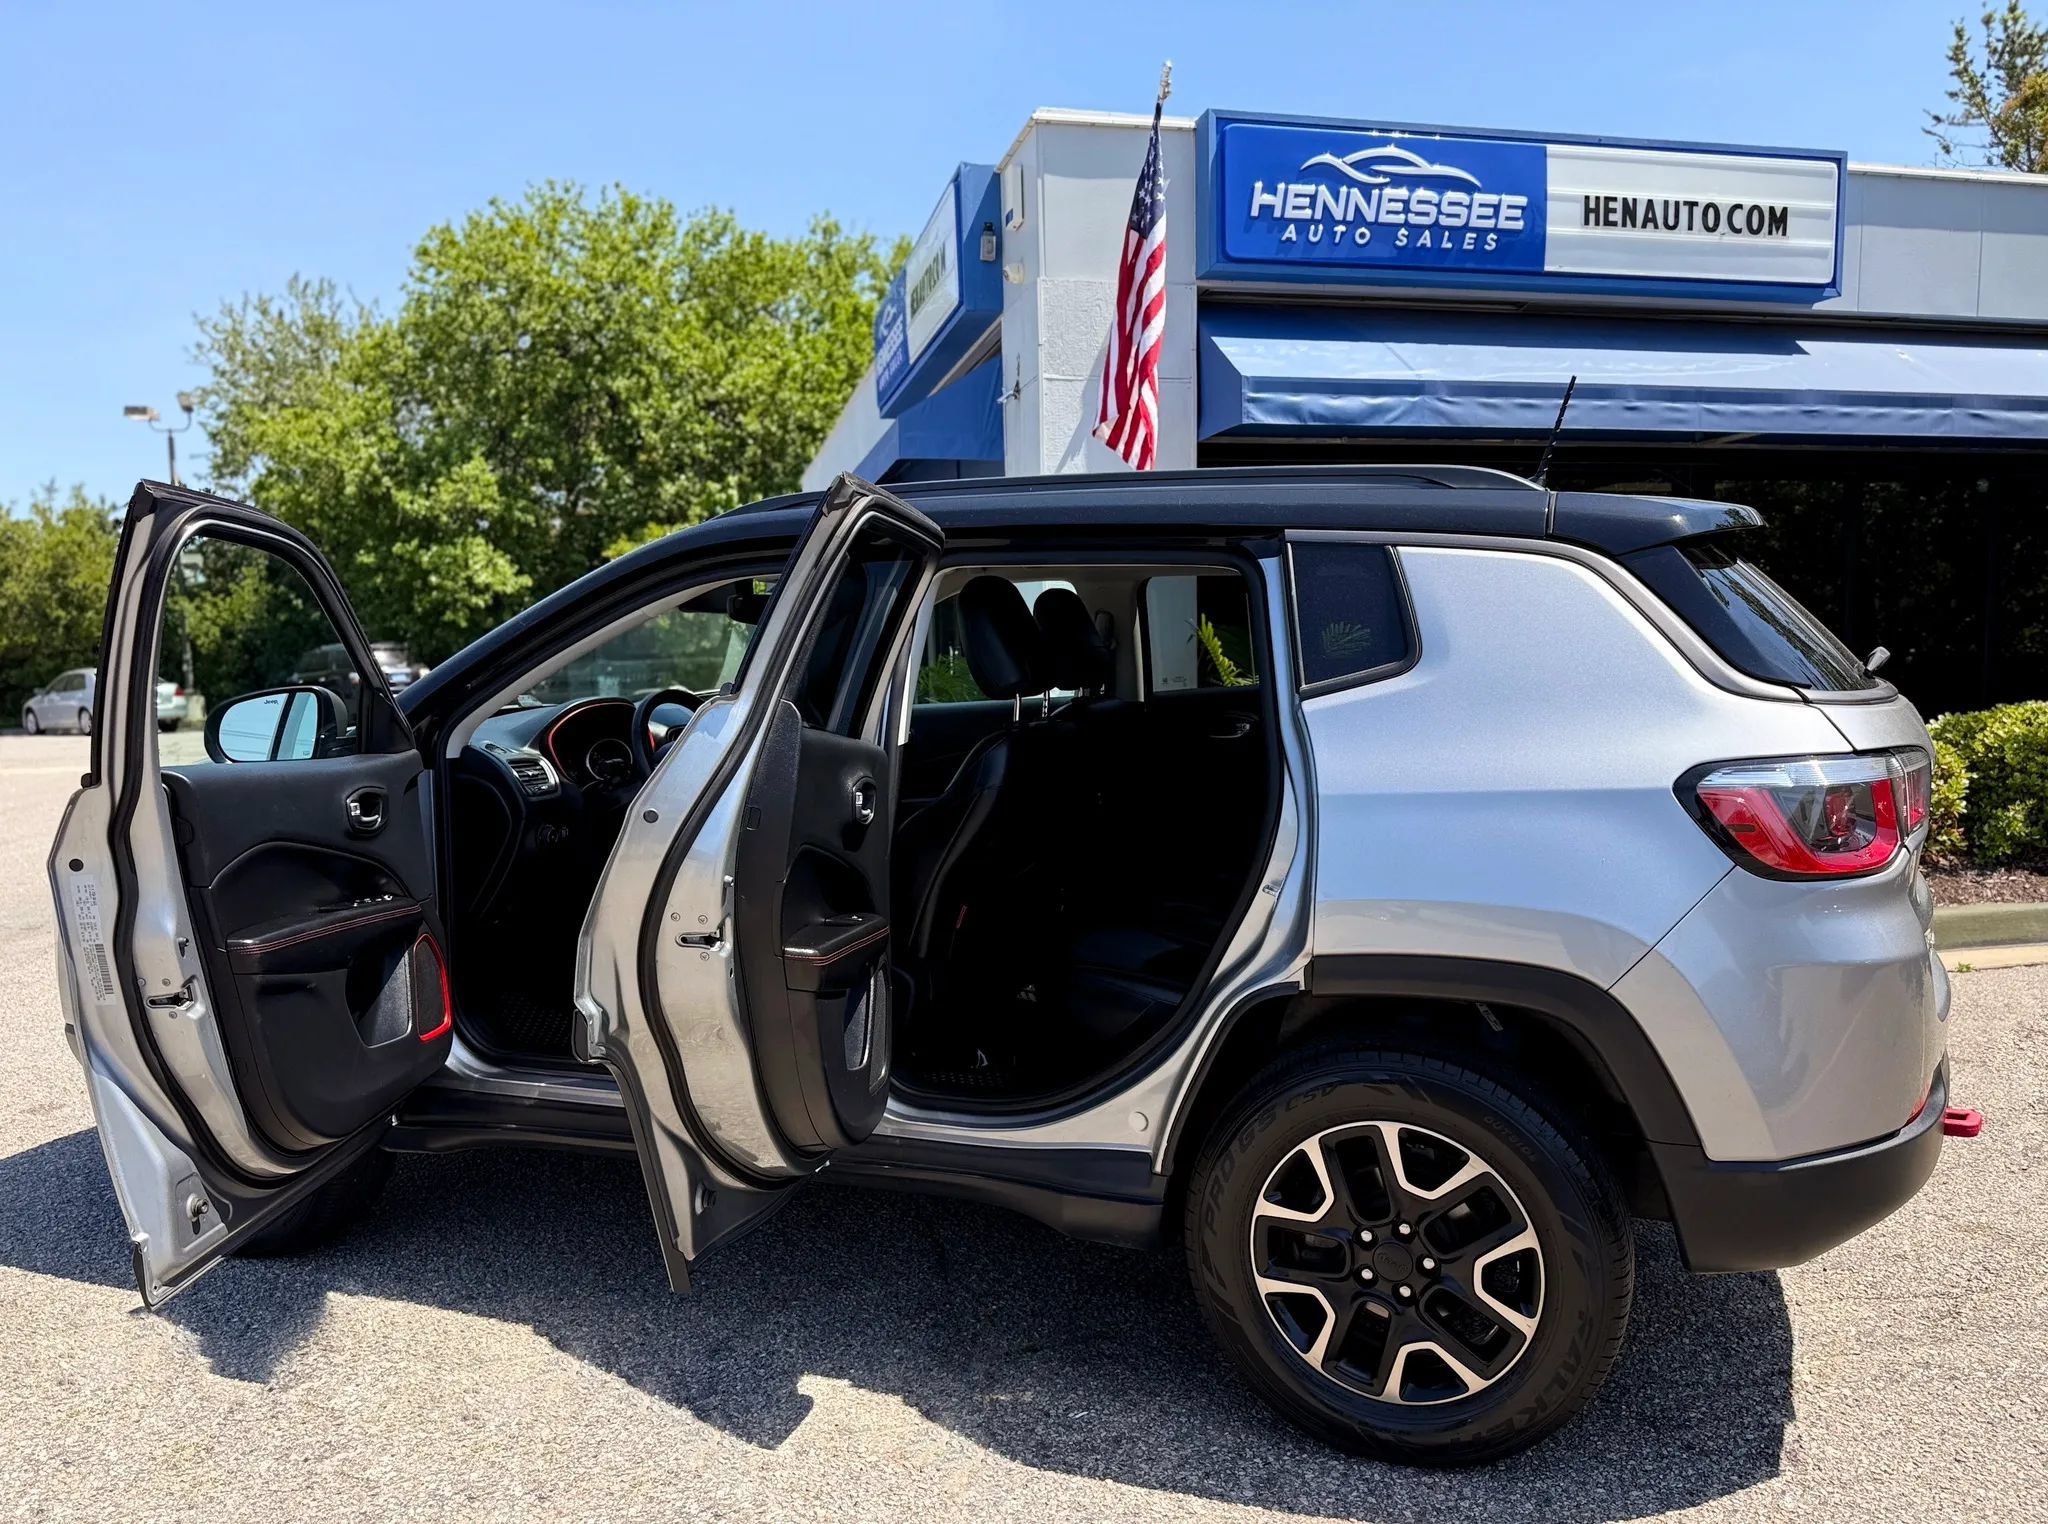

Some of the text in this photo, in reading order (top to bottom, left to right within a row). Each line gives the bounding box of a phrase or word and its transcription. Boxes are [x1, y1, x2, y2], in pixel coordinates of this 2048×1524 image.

[1250, 181, 1528, 230] HENNESSEE
[1281, 223, 1498, 251] AUTO SALES
